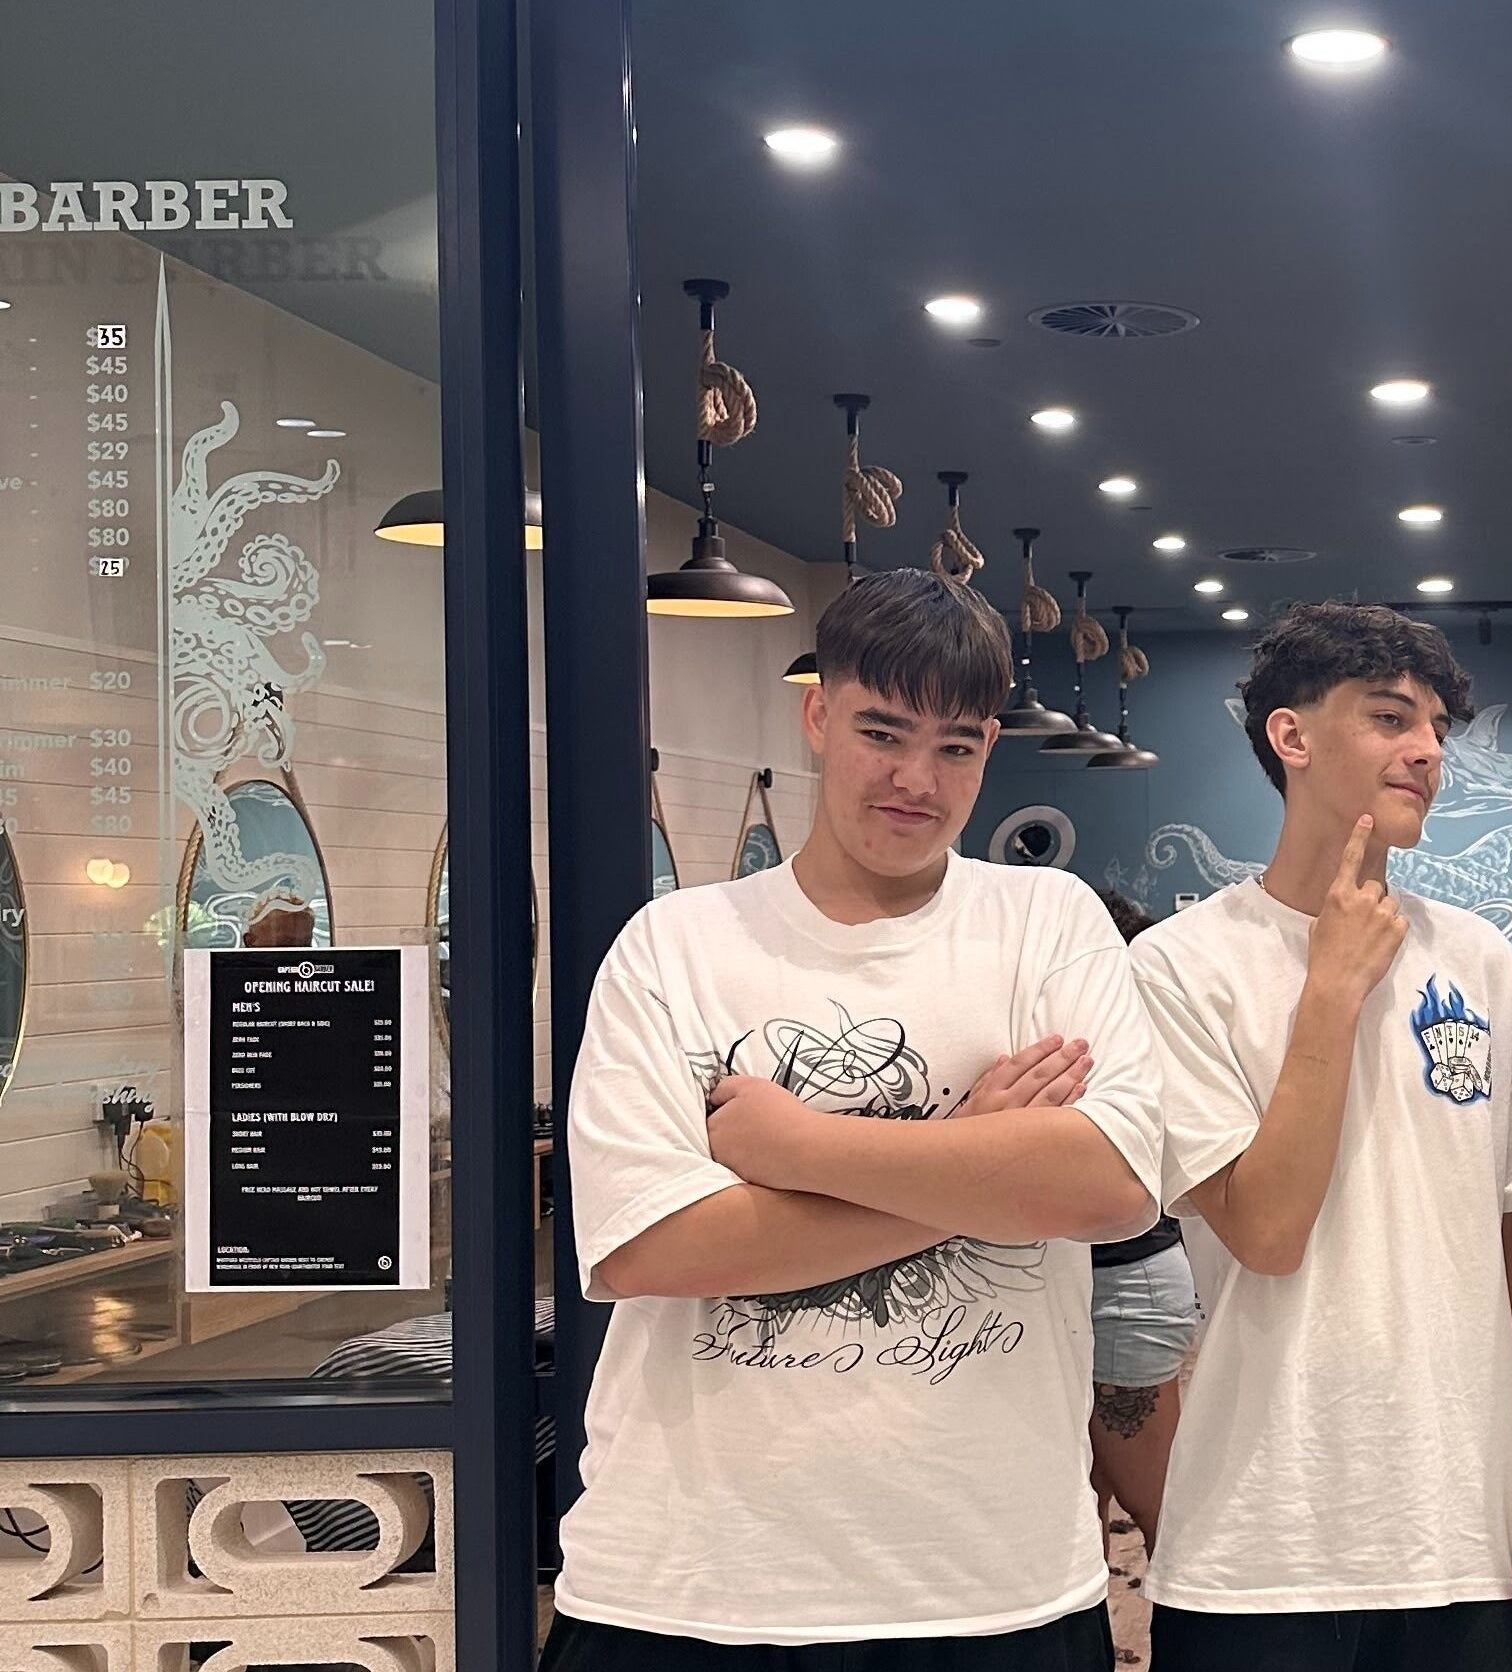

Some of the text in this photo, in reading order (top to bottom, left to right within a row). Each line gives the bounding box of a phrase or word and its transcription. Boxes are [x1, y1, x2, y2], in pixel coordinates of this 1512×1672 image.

[0, 179, 294, 232] BARBER
[86, 356, 128, 376] $45
[86, 385, 128, 405] $40
[87, 413, 128, 434] $45
[87, 442, 129, 462] $29
[87, 470, 128, 491] $45
[88, 499, 129, 519] $80
[88, 528, 129, 548] $80
[90, 670, 131, 690] $20
[90, 728, 131, 748] $30
[90, 757, 131, 776] $40
[90, 786, 131, 806] $45
[244, 979, 376, 994] OPENING HAIRCUT SALE!
[232, 1001, 261, 1013] MEN'S
[232, 1112, 338, 1124] LADIES (WITH BLOW DRY)
[692, 1304, 1025, 1386] Future Light
